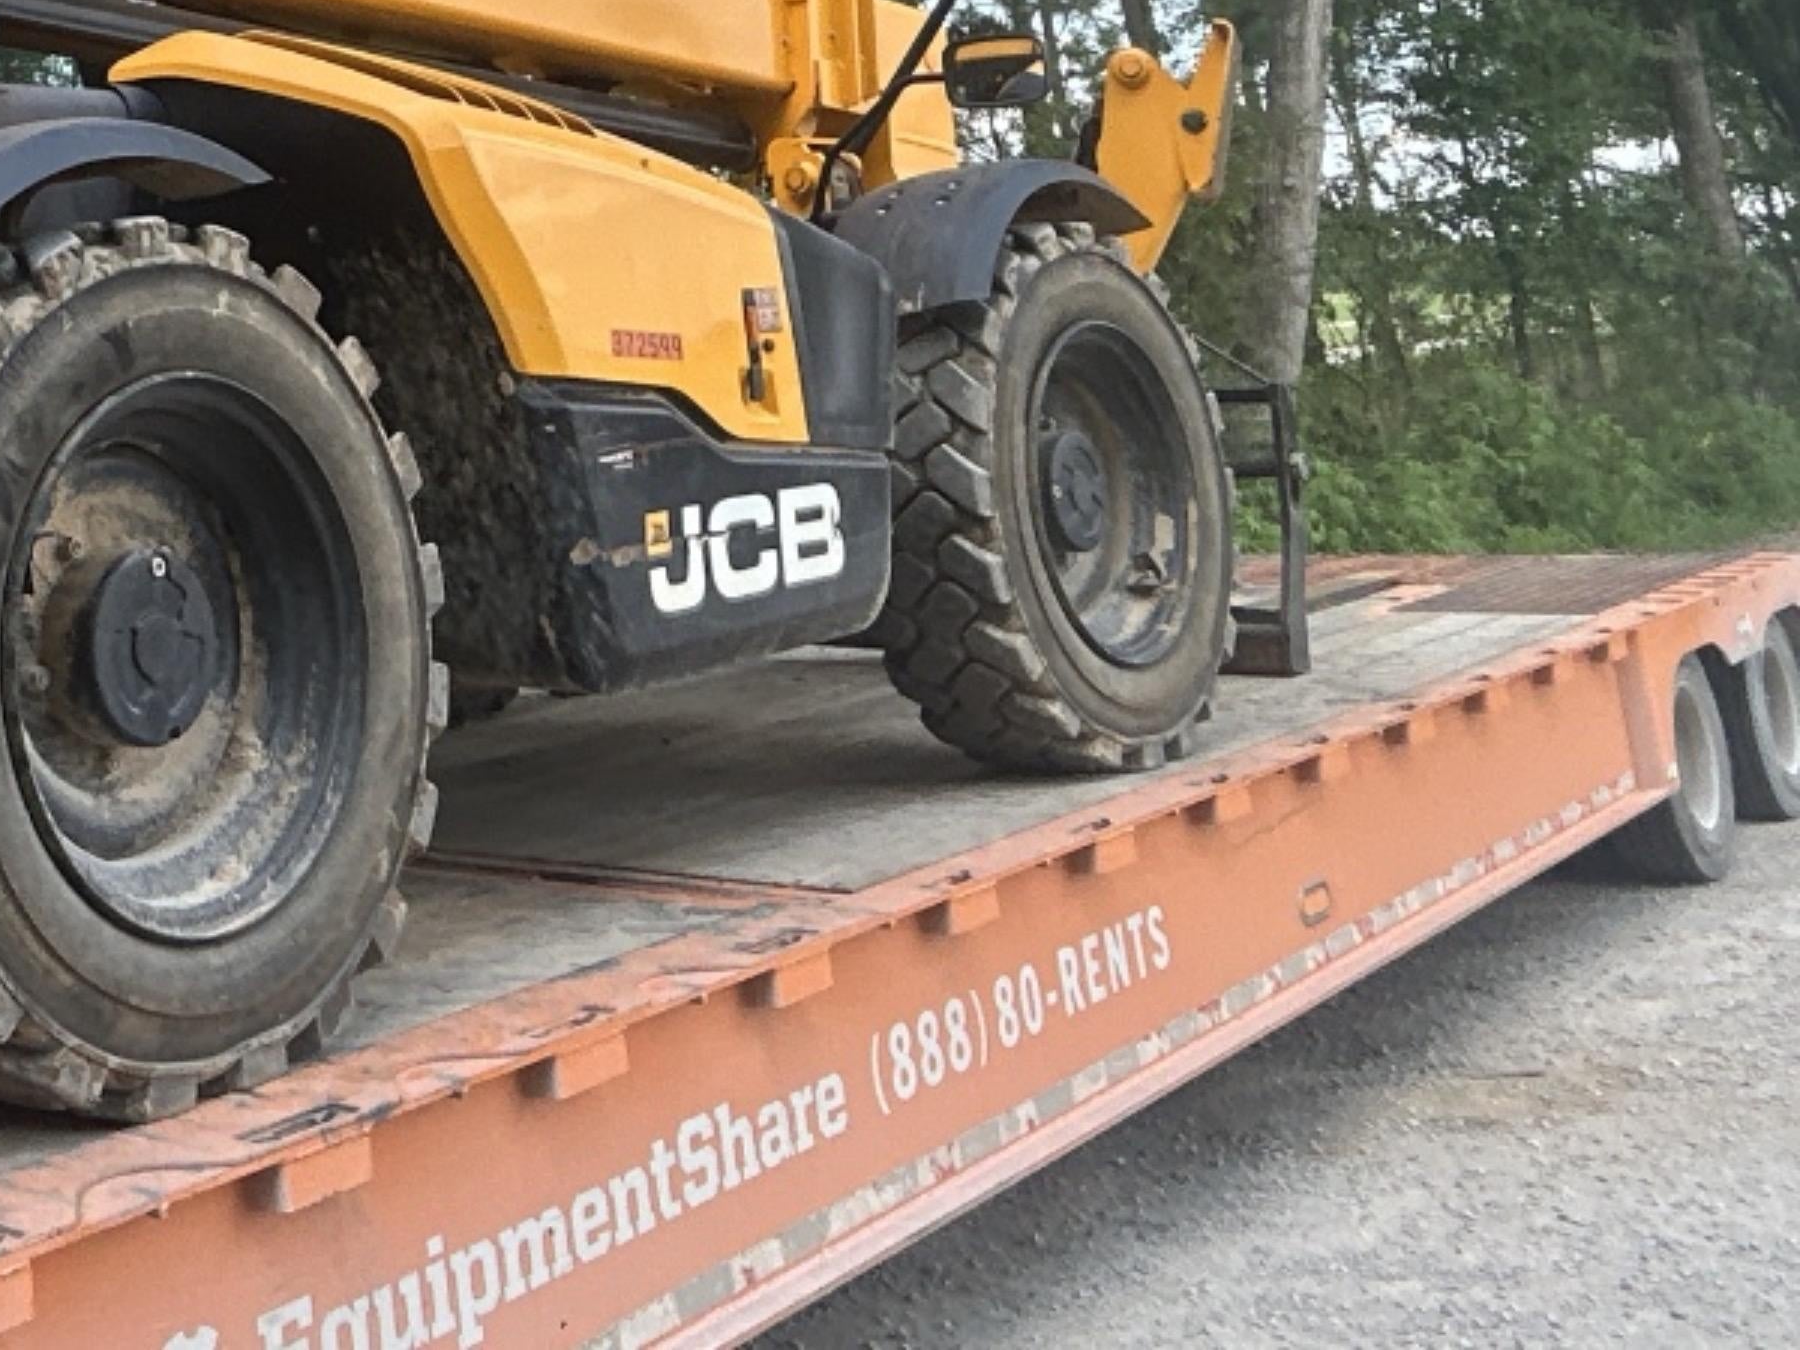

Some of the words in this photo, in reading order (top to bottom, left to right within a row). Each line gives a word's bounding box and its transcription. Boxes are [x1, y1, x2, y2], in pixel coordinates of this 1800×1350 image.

[649, 482, 845, 613] JCB
[870, 989, 988, 1116] (888)
[993, 905, 1170, 1049] 80-RENTS
